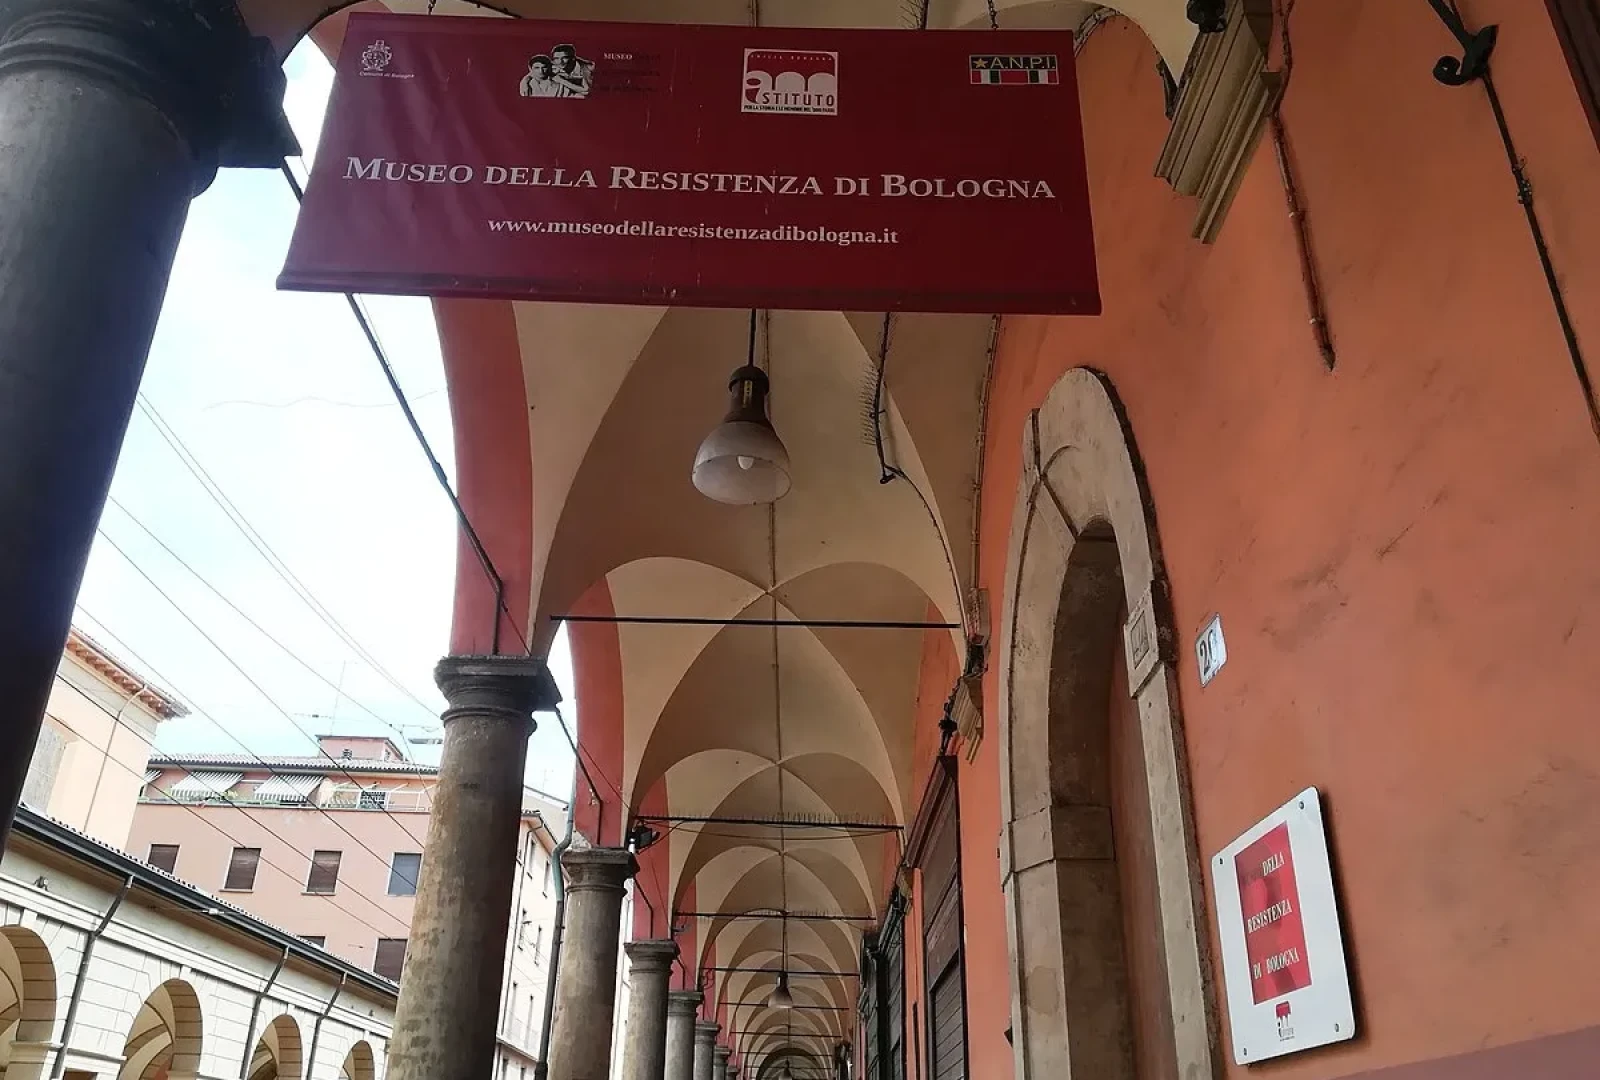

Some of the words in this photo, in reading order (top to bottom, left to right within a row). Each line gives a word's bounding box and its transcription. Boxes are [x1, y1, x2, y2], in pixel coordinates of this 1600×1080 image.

[603, 52, 633, 60] MUSEO
[990, 56, 1056, 69] A.N.P.I.
[342, 156, 473, 184] MUSEO
[483, 165, 598, 189] DELLA
[608, 166, 824, 196] RESISTENZA
[834, 177, 870, 196] DI
[880, 174, 1056, 199] BOLOGNA
[487, 219, 899, 246] www.museodellaresistenzadibologna.it
[1262, 852, 1285, 876] DELLA
[1247, 898, 1292, 934] RESISTENZA
[1253, 962, 1262, 980] DI
[1266, 947, 1300, 974] BOLOGNA
